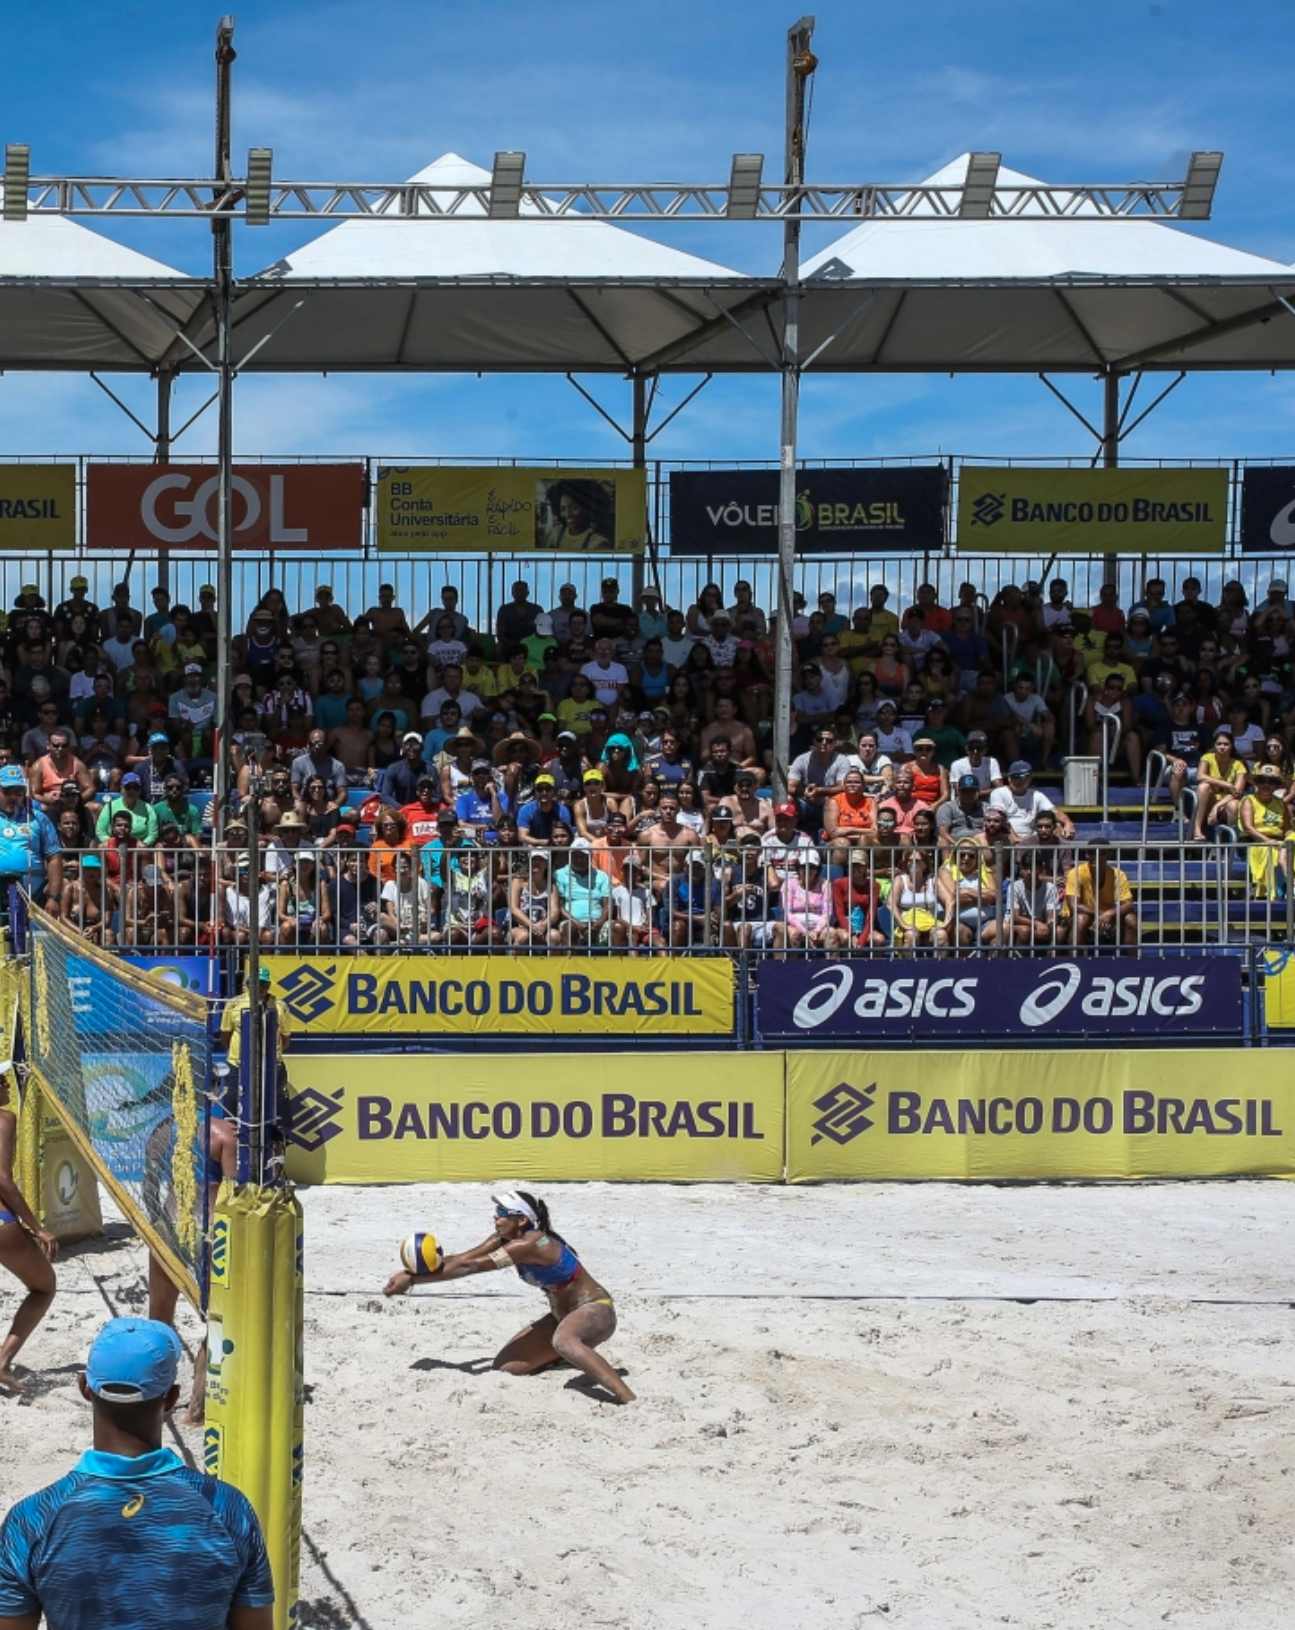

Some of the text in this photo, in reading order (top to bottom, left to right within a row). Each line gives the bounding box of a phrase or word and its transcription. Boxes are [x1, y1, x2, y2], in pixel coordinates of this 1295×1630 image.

[140, 473, 308, 543] GOL
[390, 482, 412, 495] BB
[390, 498, 433, 511] Conta
[390, 512, 478, 526] Universitária
[706, 501, 905, 526] VÔLEI BRASIL
[1011, 498, 1214, 523] BANCO DO BRASIL
[347, 973, 702, 1016] BANCO DO BRASIL
[854, 977, 978, 1018] asics
[1081, 975, 1205, 1016] asics
[357, 1093, 765, 1140] BANCO DO BRASIL
[887, 1089, 1283, 1136] BANCO DO BRASIL
